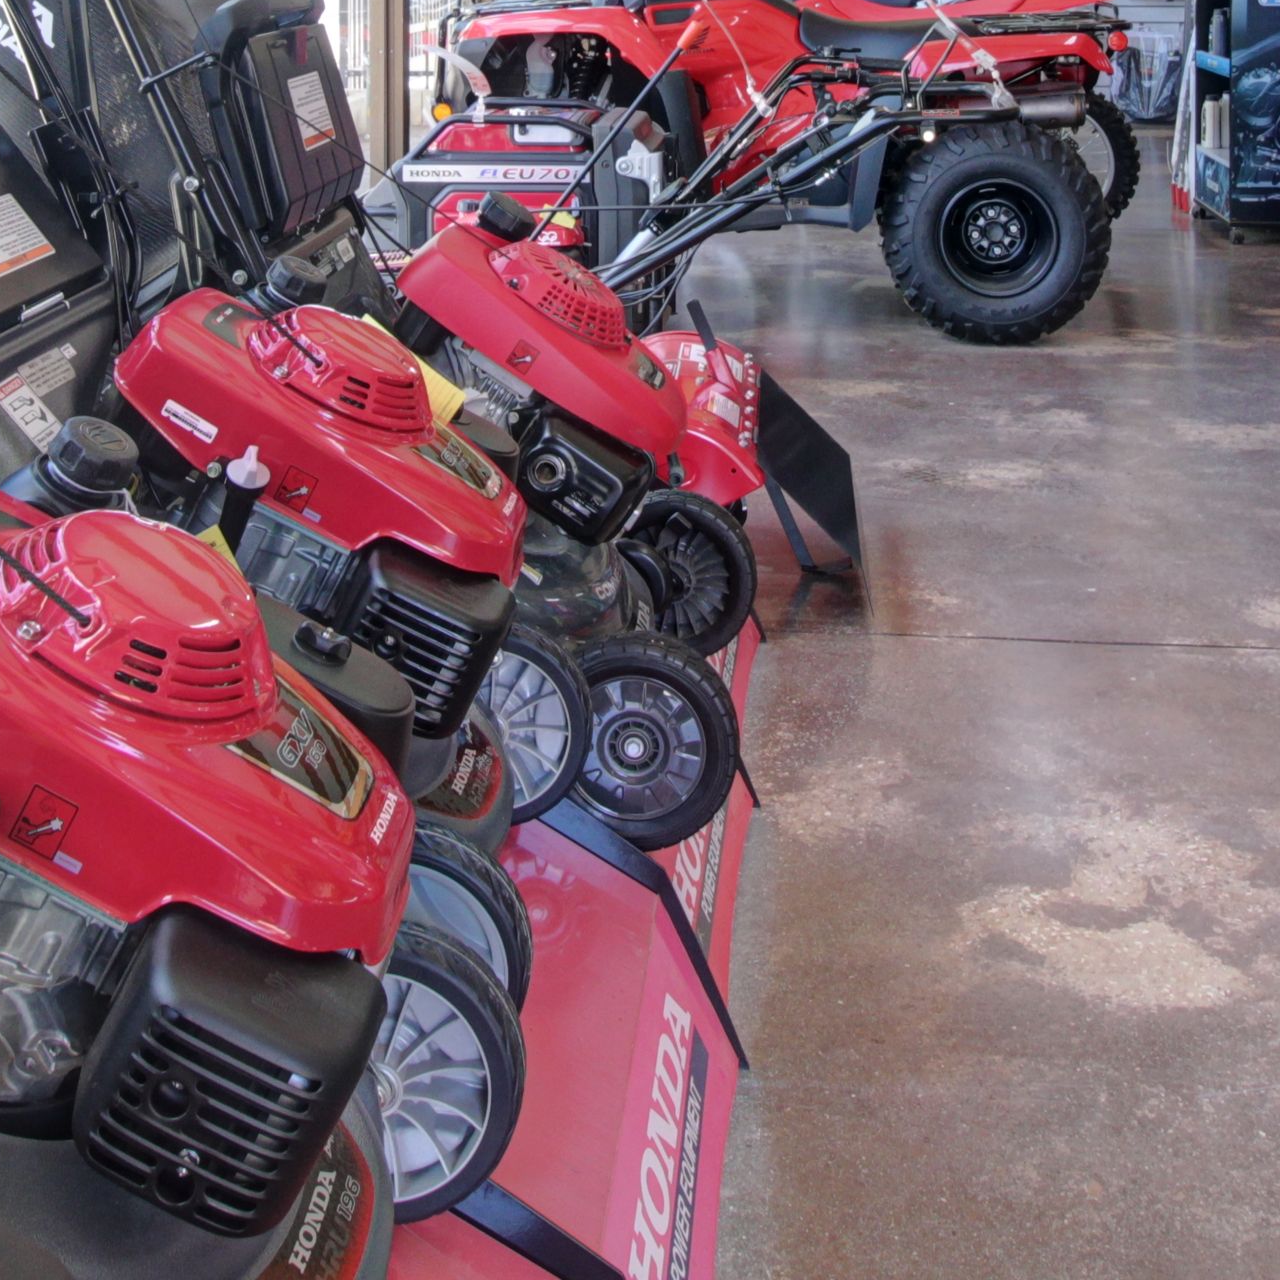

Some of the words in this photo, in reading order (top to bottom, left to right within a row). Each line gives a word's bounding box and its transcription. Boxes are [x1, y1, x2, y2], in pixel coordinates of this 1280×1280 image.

[410, 169, 462, 178] HONDA
[480, 168, 498, 178] FI
[502, 167, 587, 181] EU70i
[276, 707, 314, 768] GXV
[305, 739, 327, 769] 160
[451, 748, 477, 796] HONDA
[370, 791, 398, 846] HONDA
[628, 992, 691, 1280] HONDA
[679, 1074, 704, 1207] EQUIPMENT
[288, 1170, 337, 1275] HONDA
[669, 1193, 693, 1280] POWER
